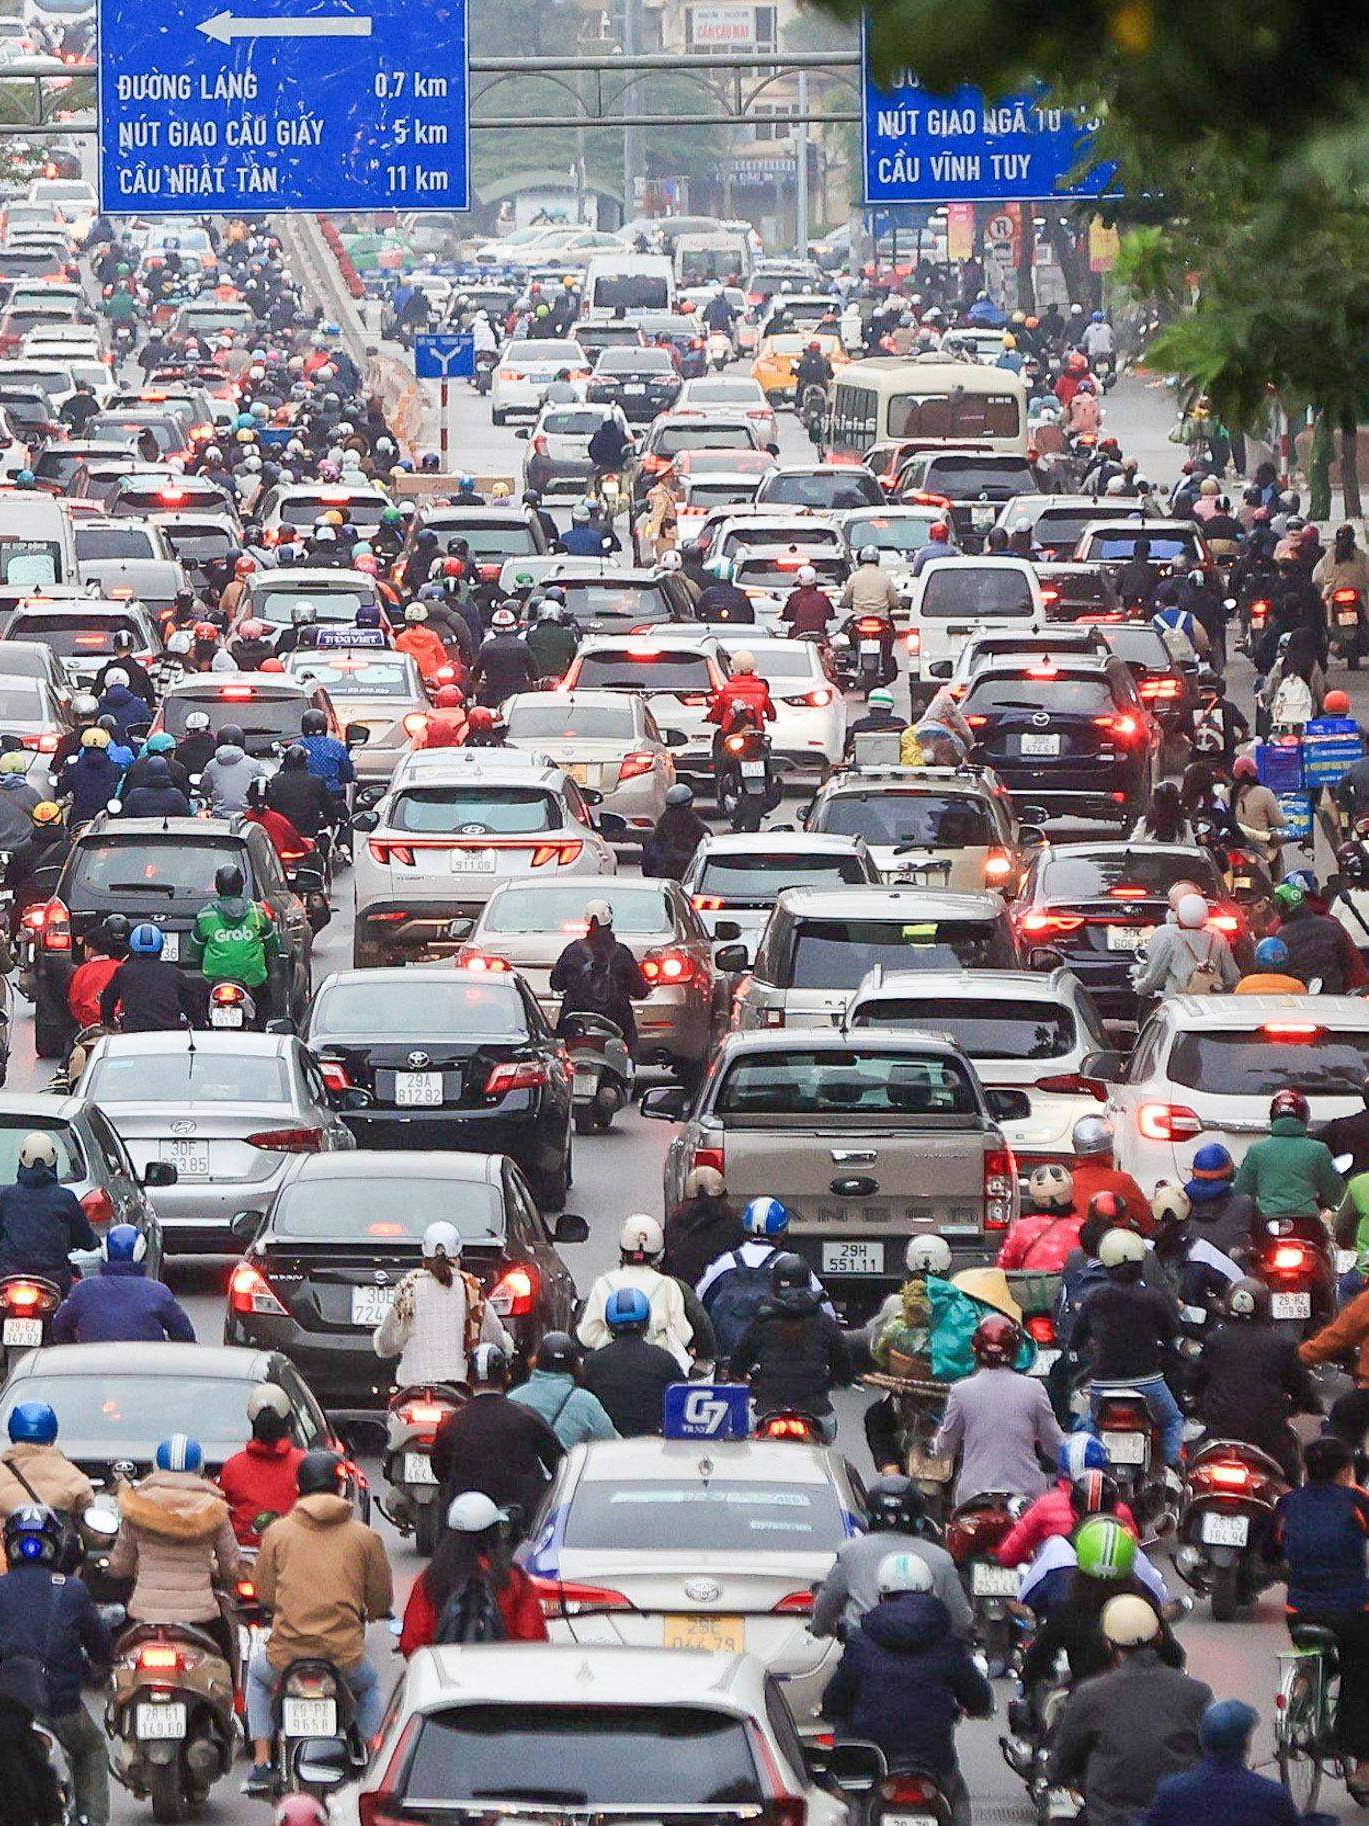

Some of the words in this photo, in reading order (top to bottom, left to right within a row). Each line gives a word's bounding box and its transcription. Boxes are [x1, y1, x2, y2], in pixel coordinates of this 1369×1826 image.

[118, 67, 192, 100] ĐƯỜNG
[200, 66, 258, 101] LÁNG
[375, 71, 406, 100] 0,7
[414, 73, 448, 98] km
[119, 113, 161, 147] NÚT
[168, 121, 219, 147] GIAO
[226, 112, 268, 147] CẦU
[276, 111, 324, 146] GIẤY
[395, 118, 408, 145] 5
[415, 120, 448, 145] km
[878, 102, 921, 136] NÚT
[927, 109, 977, 136] GIAO
[983, 102, 1027, 135] NGÃ
[120, 161, 161, 194] CẦU
[170, 161, 226, 195] NHẬT
[236, 161, 278, 193] TÂN
[387, 166, 405, 191] 11
[416, 166, 449, 191] km
[878, 149, 920, 183] CẦU
[930, 150, 980, 182] VĨNH
[990, 154, 1031, 180] TUY
[214, 926, 254, 943] Grab
[407, 1074, 431, 1087] 29A
[398, 1088, 441, 1103] 812.82
[172, 1141, 197, 1156] 30F
[841, 1245, 867, 1257] 29H
[829, 1258, 877, 1271] 551.11
[685, 1390, 729, 1434] G7
